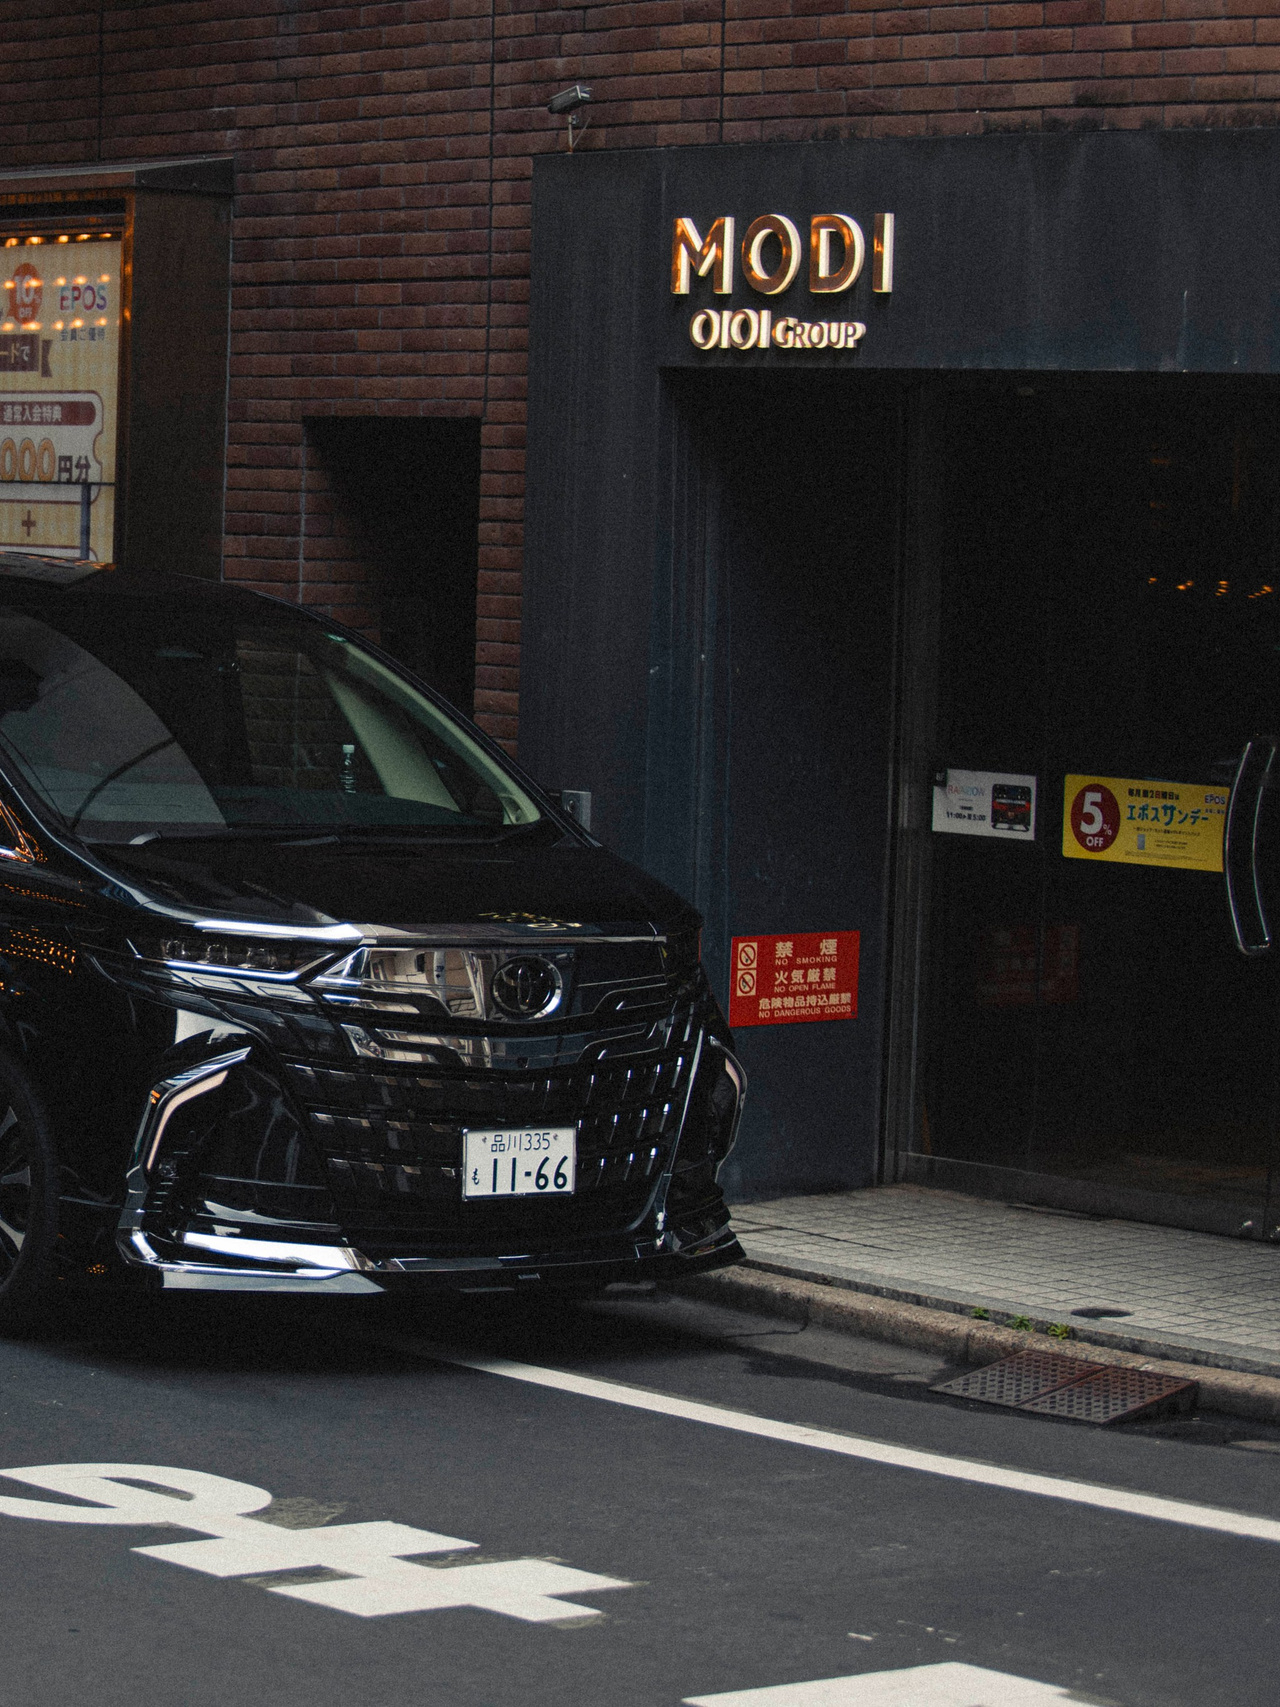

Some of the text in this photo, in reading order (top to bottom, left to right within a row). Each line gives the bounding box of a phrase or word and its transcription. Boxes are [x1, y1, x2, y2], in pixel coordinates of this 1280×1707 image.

[671, 212, 895, 295] MODI
[59, 284, 108, 311] EPOS
[3, 404, 62, 423] 通常入会特典
[1204, 793, 1226, 805] EPOS
[1126, 803, 1209, 826] エポスサンデー
[1086, 836, 1104, 848] OFF
[775, 955, 838, 966] NO SMOKING
[774, 967, 836, 985] 火気厳禁
[774, 982, 836, 993] NO OPEN FLAME
[759, 992, 852, 1010] 危険物品持込厳禁
[758, 1005, 851, 1019] NO DANGEROUS GOODS
[492, 1155, 568, 1193] 11-66
